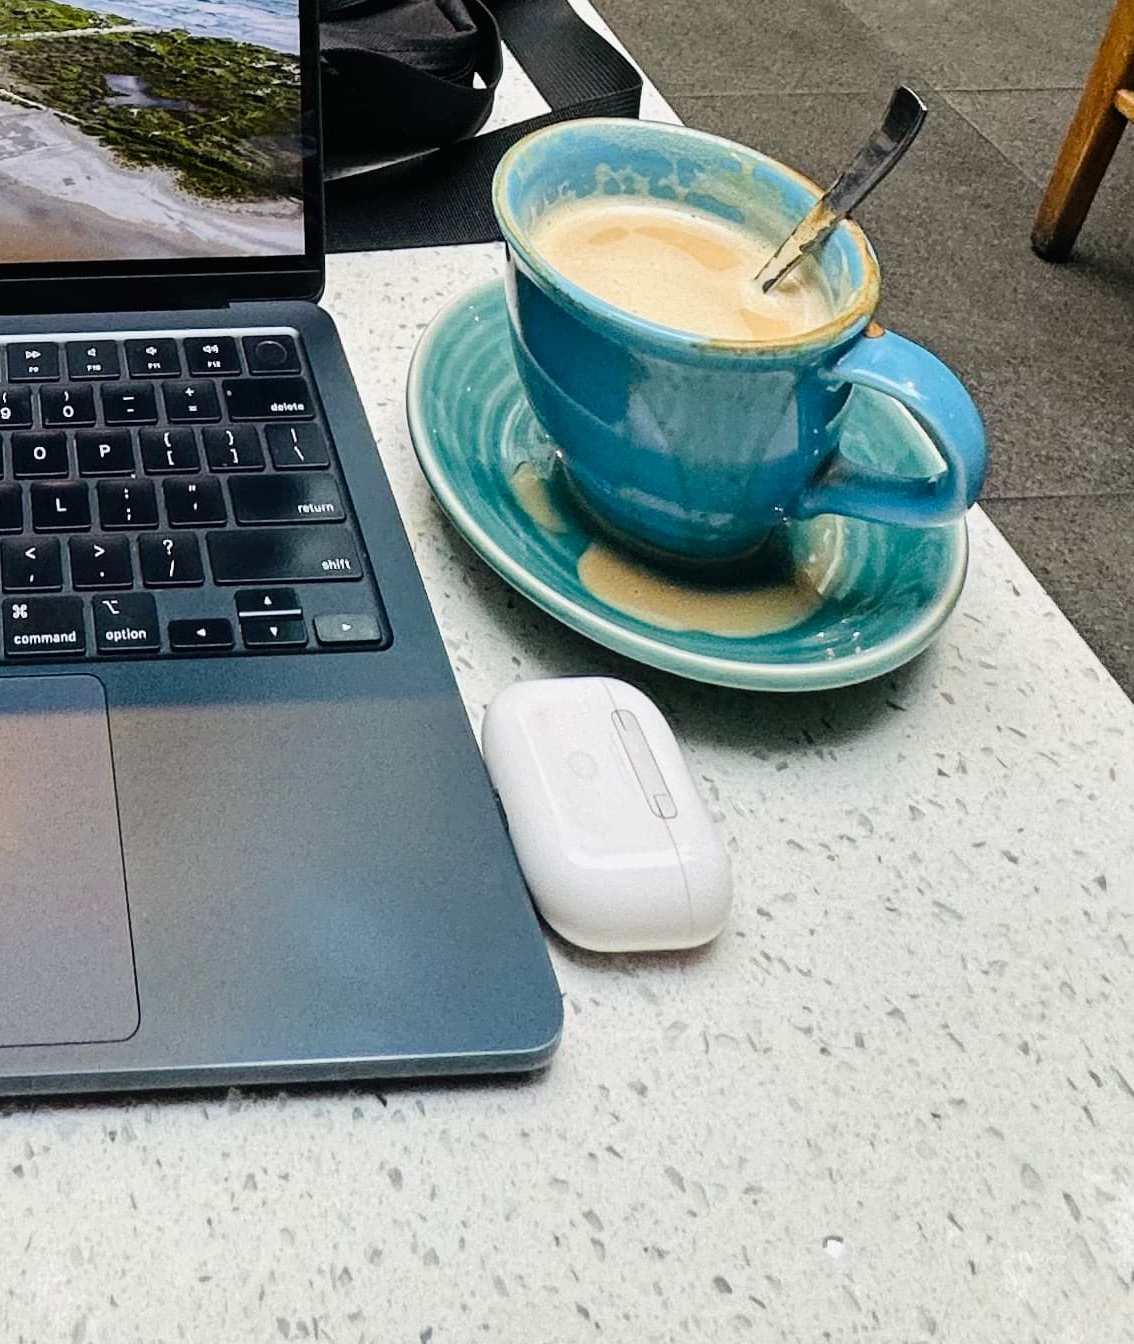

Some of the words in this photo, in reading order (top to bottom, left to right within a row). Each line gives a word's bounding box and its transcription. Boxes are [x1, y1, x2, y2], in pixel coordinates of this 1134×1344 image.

[0, 406, 12, 420] 9
[62, 405, 75, 418] 0
[270, 402, 305, 412] delete
[33, 446, 47, 460] O
[98, 444, 111, 458] P
[55, 497, 67, 512] L
[297, 503, 335, 514] return
[162, 539, 174, 556] ?
[321, 558, 351, 571] shift
[13, 630, 77, 645] command
[105, 627, 147, 643] option
